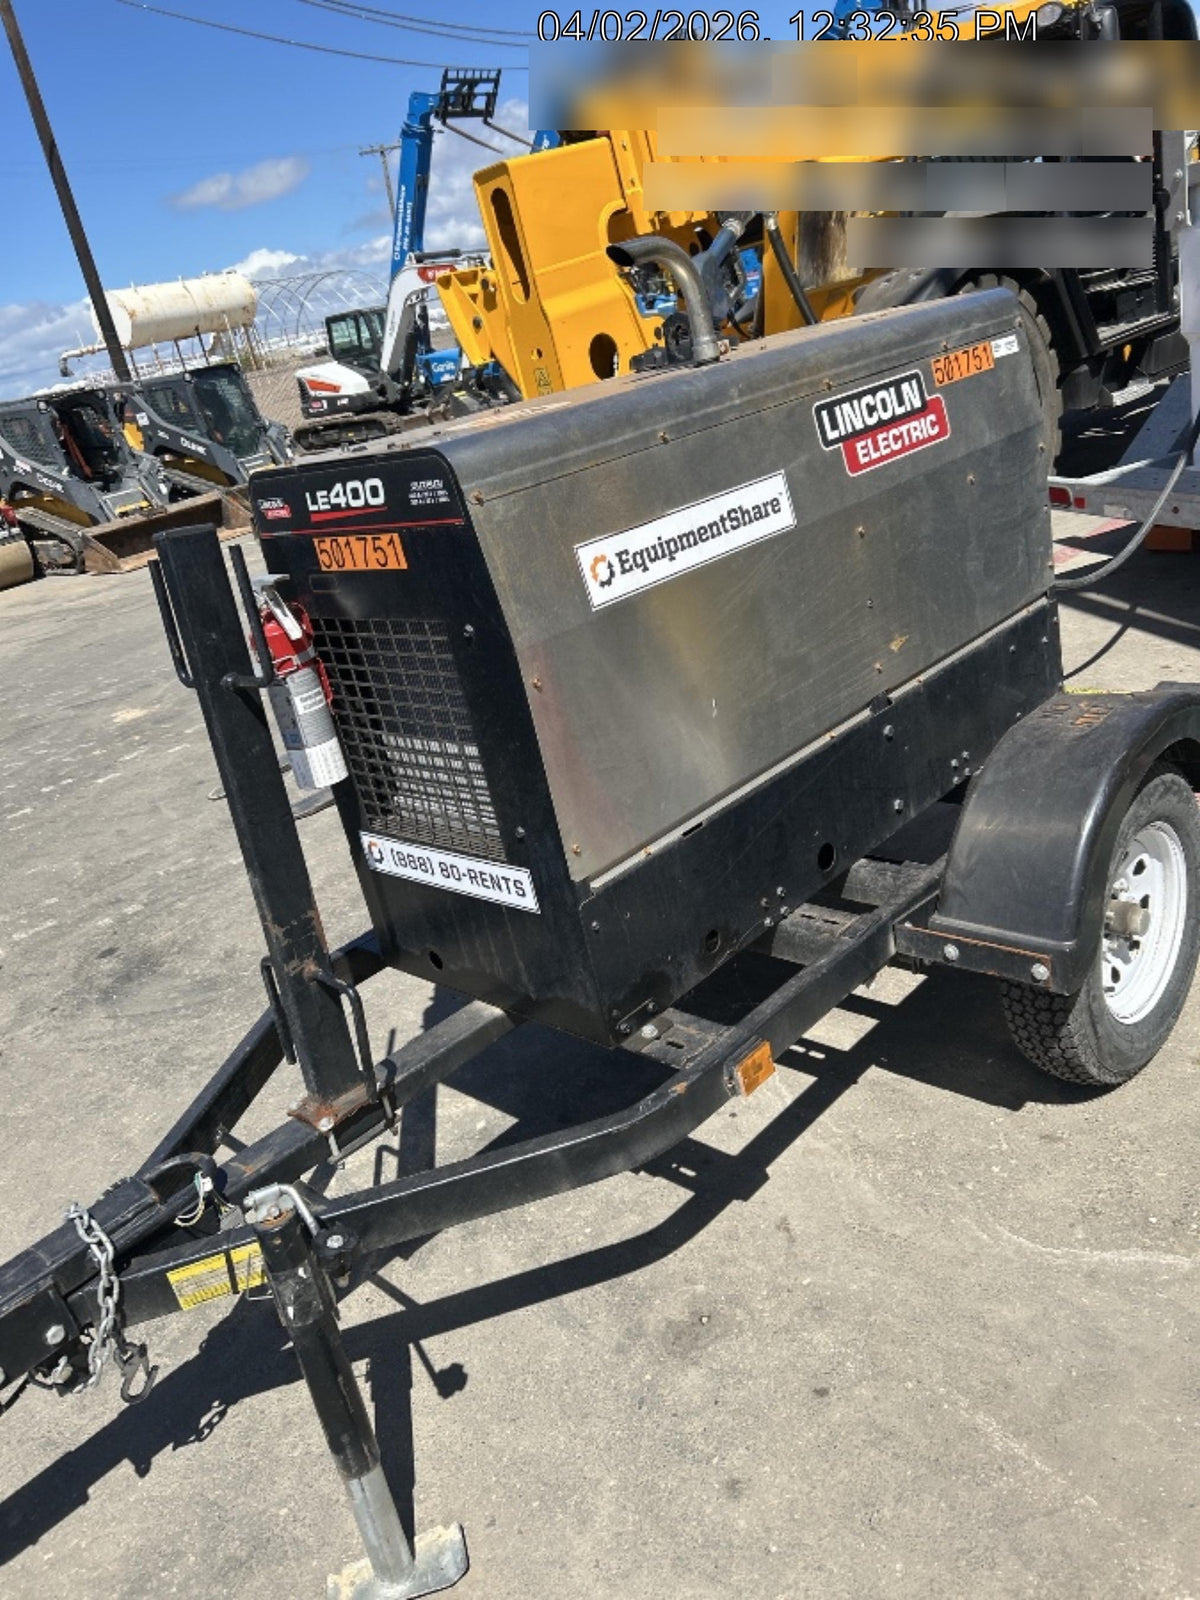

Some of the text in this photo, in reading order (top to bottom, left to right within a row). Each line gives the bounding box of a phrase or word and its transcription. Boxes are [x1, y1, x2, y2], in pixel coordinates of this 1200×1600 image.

[933, 346, 992, 384] 501751
[821, 378, 923, 441] LINCOLN
[856, 413, 940, 465] ELECTRIC
[305, 477, 385, 512] LE400
[316, 536, 401, 570] 501751
[615, 496, 783, 574] EquipmentShare
[390, 847, 527, 898] (888) 80-RENTS
